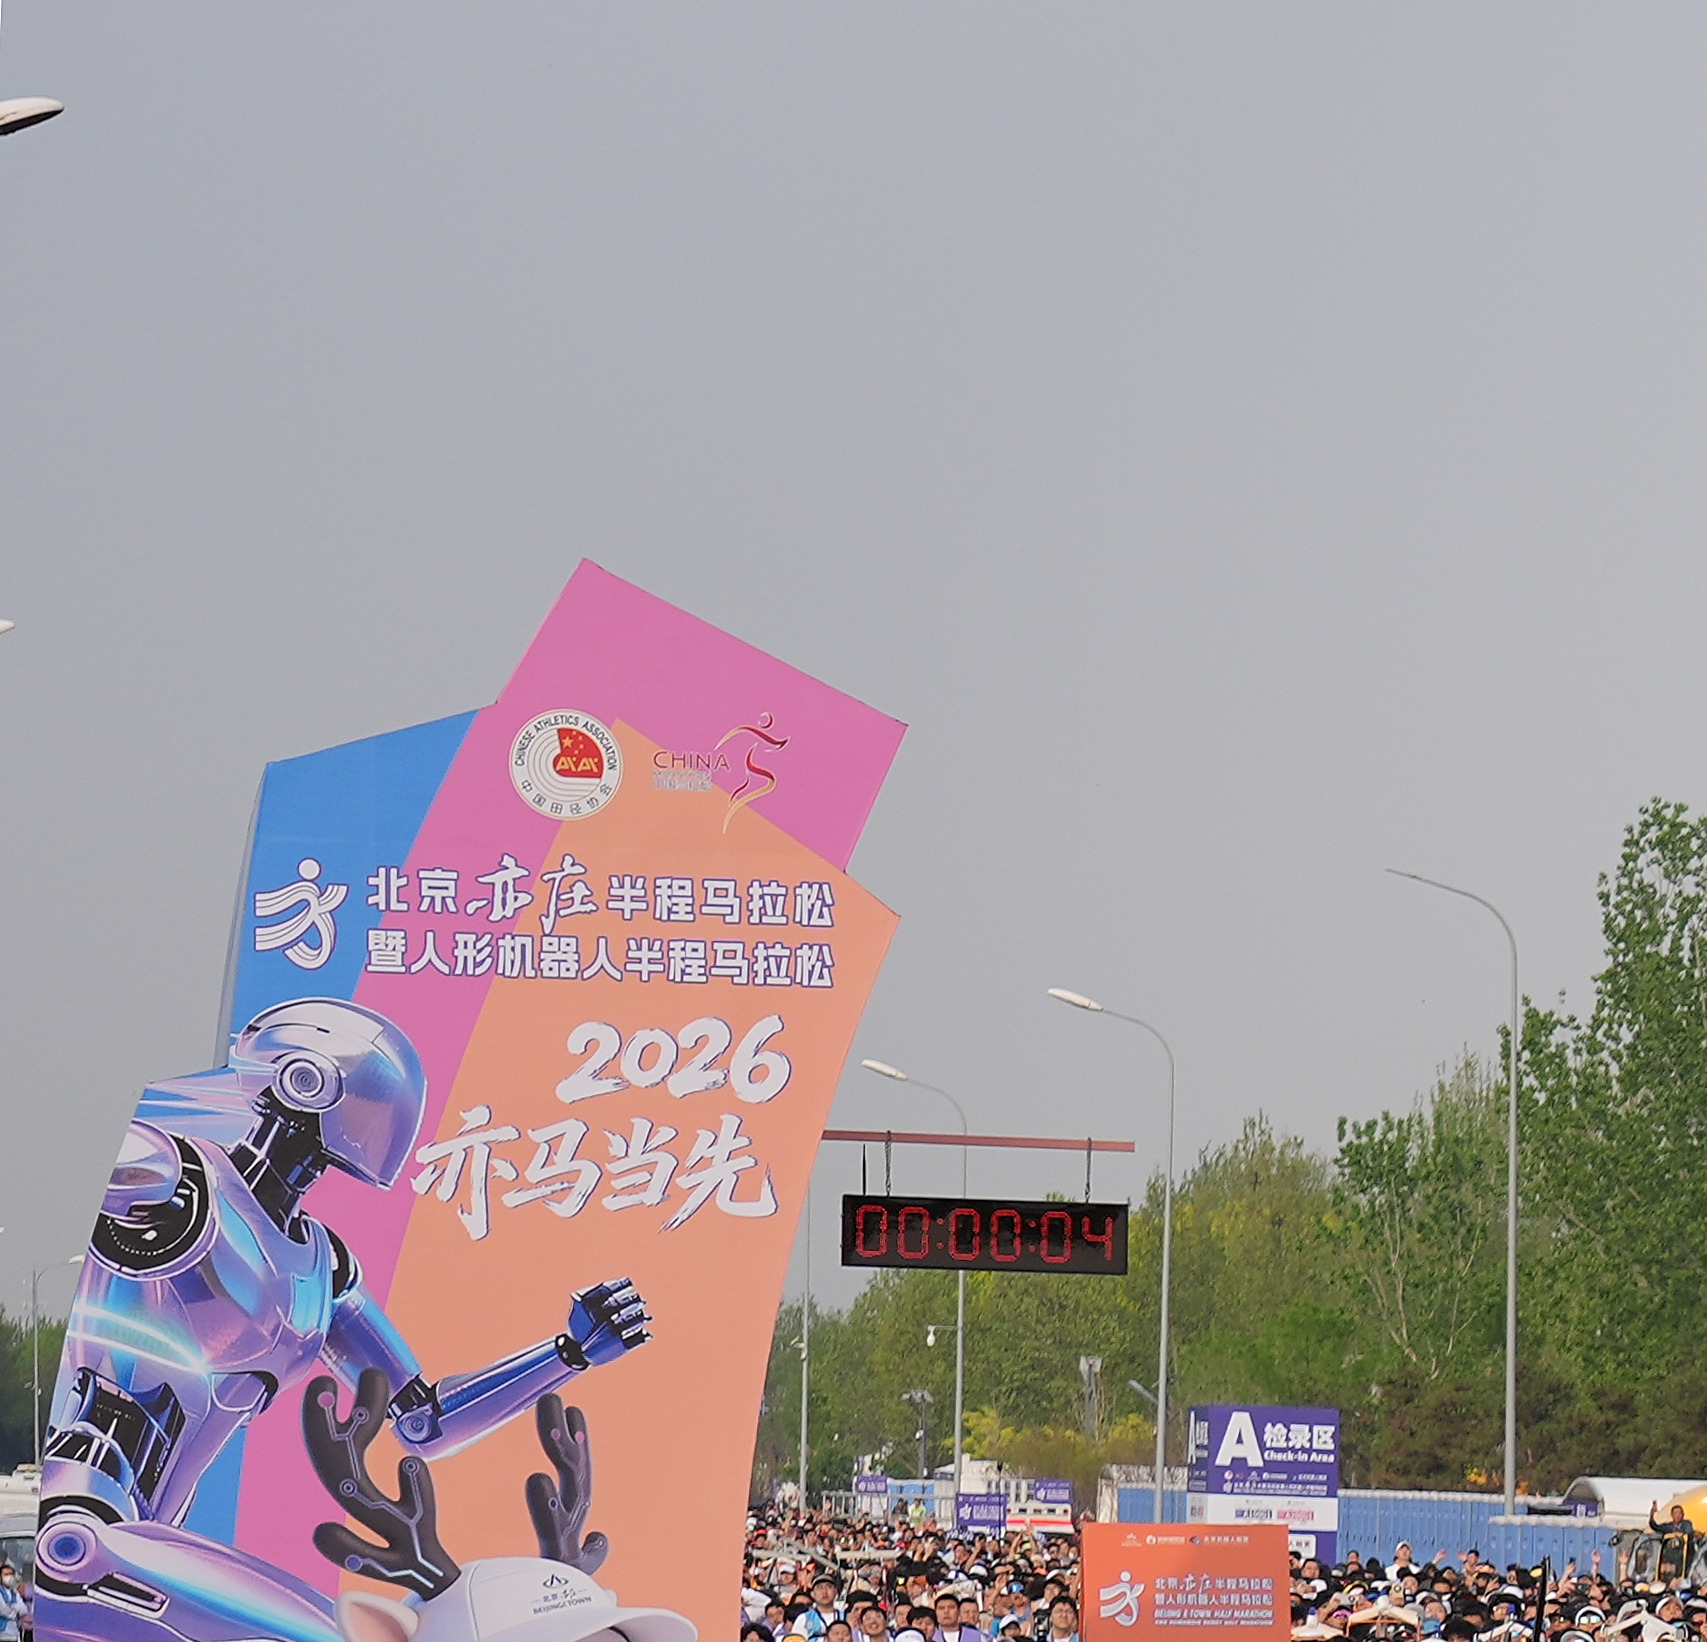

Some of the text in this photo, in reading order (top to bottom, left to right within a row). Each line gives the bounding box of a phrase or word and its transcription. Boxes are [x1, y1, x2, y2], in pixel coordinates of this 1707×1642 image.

[514, 714, 618, 771] CHINESE ATHLETICS ASSOCIATION
[653, 751, 731, 772] CHINA
[366, 853, 835, 935] 北京亦庄半程马拉松
[366, 928, 835, 989] 暨人形机器人半程马拉松
[555, 1013, 792, 1105] 2026
[410, 1104, 780, 1241] 亦马当先
[854, 1203, 1114, 1262] 00:00:04
[1215, 1411, 1264, 1467] A
[1264, 1422, 1336, 1450] 检录区
[1310, 1451, 1335, 1463] Area
